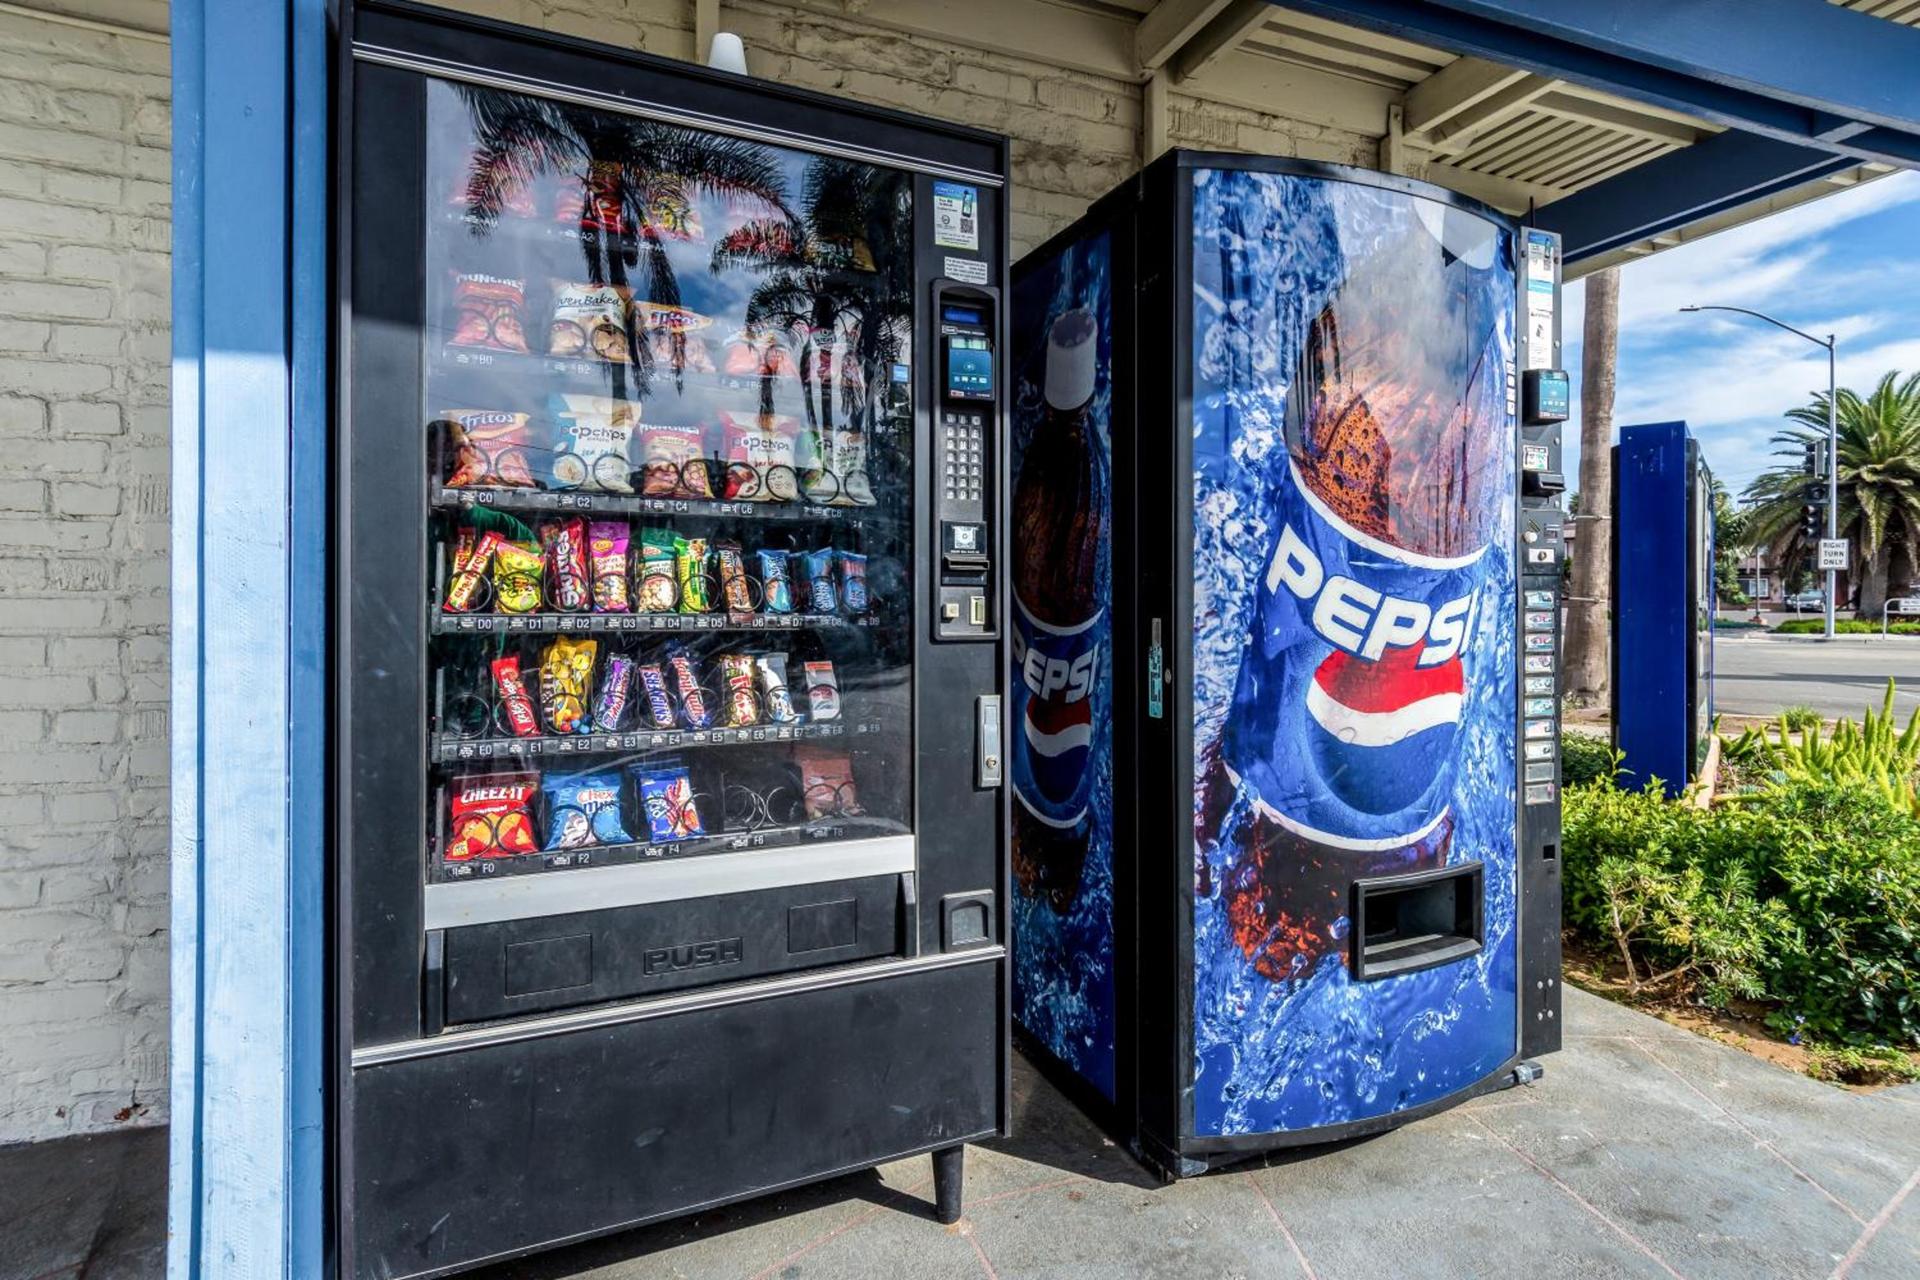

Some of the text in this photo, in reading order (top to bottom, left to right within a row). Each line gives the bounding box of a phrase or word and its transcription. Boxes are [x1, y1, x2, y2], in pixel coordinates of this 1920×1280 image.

[584, 295, 622, 307] Baked
[459, 412, 514, 432] Fritos
[561, 426, 626, 441] popchips
[732, 437, 790, 450] popchips
[577, 498, 591, 508] C2
[675, 502, 688, 511] C4
[741, 506, 753, 515] C6
[1266, 523, 1479, 668] PEPSI
[529, 620, 541, 629] D1
[577, 619, 589, 628] D2
[623, 619, 636, 628] D3
[668, 617, 680, 627] D4
[711, 617, 723, 627] D5
[1012, 620, 1099, 704] PEPSI
[669, 736, 680, 744] E4
[712, 733, 723, 742] E5
[754, 731, 764, 740] E6
[578, 740, 590, 749] E2
[624, 738, 636, 747] E3
[530, 744, 541, 752] E1
[461, 786, 526, 804] CHEEZ-IT
[577, 789, 615, 804] Chex
[669, 845, 680, 854] F4
[578, 854, 590, 863] F2
[643, 937, 743, 976] PUSH
